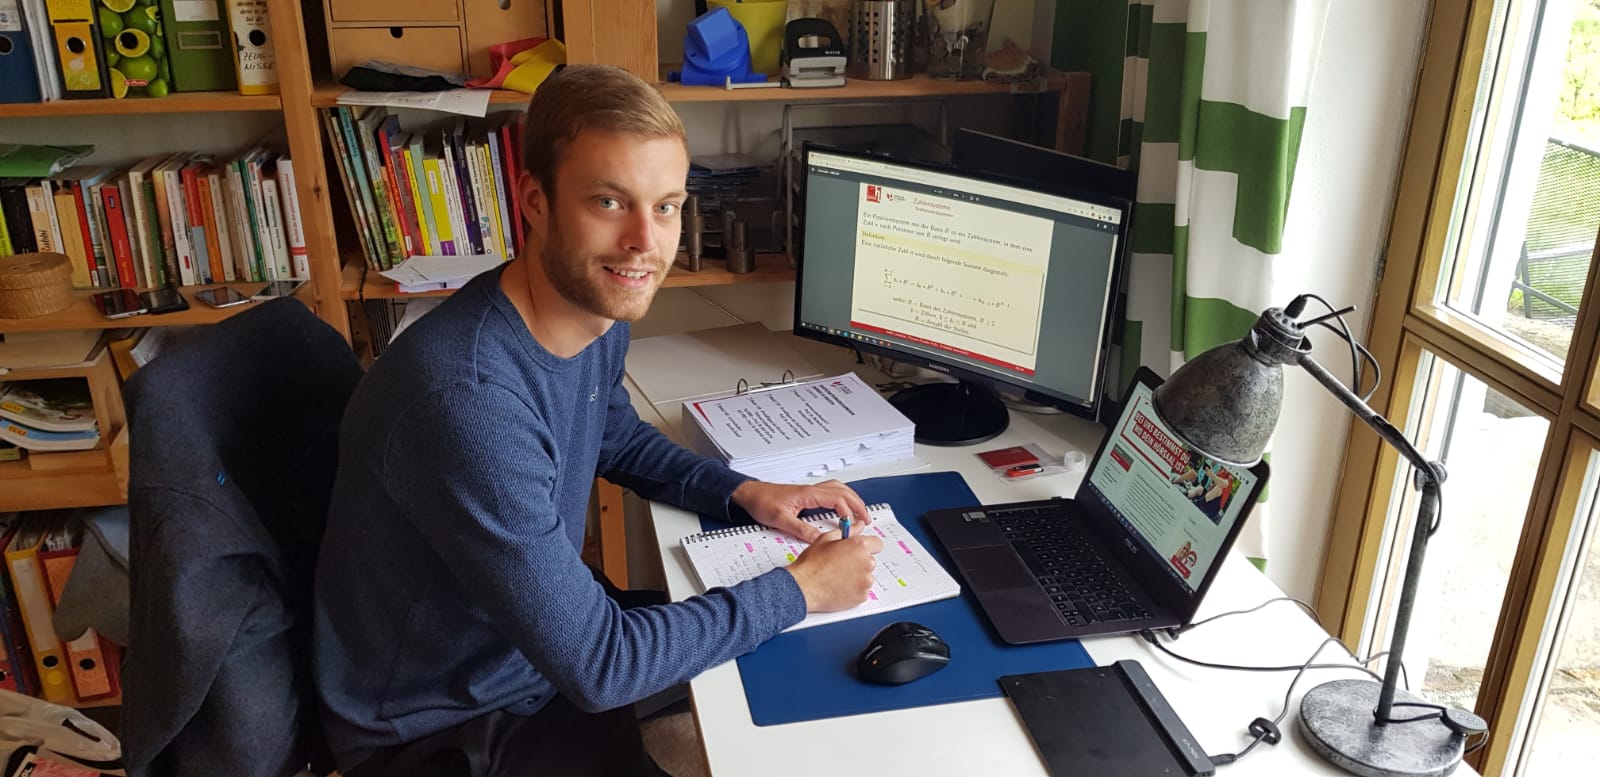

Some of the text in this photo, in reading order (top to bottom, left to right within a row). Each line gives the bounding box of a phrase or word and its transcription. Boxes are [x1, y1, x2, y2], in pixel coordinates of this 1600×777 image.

[1134, 423, 1143, 436] WO
[1141, 431, 1155, 446] DEIN
[1152, 440, 1176, 466] HÖRSAAL
[1135, 412, 1191, 464] BEI UNS BESTIMMST DU
